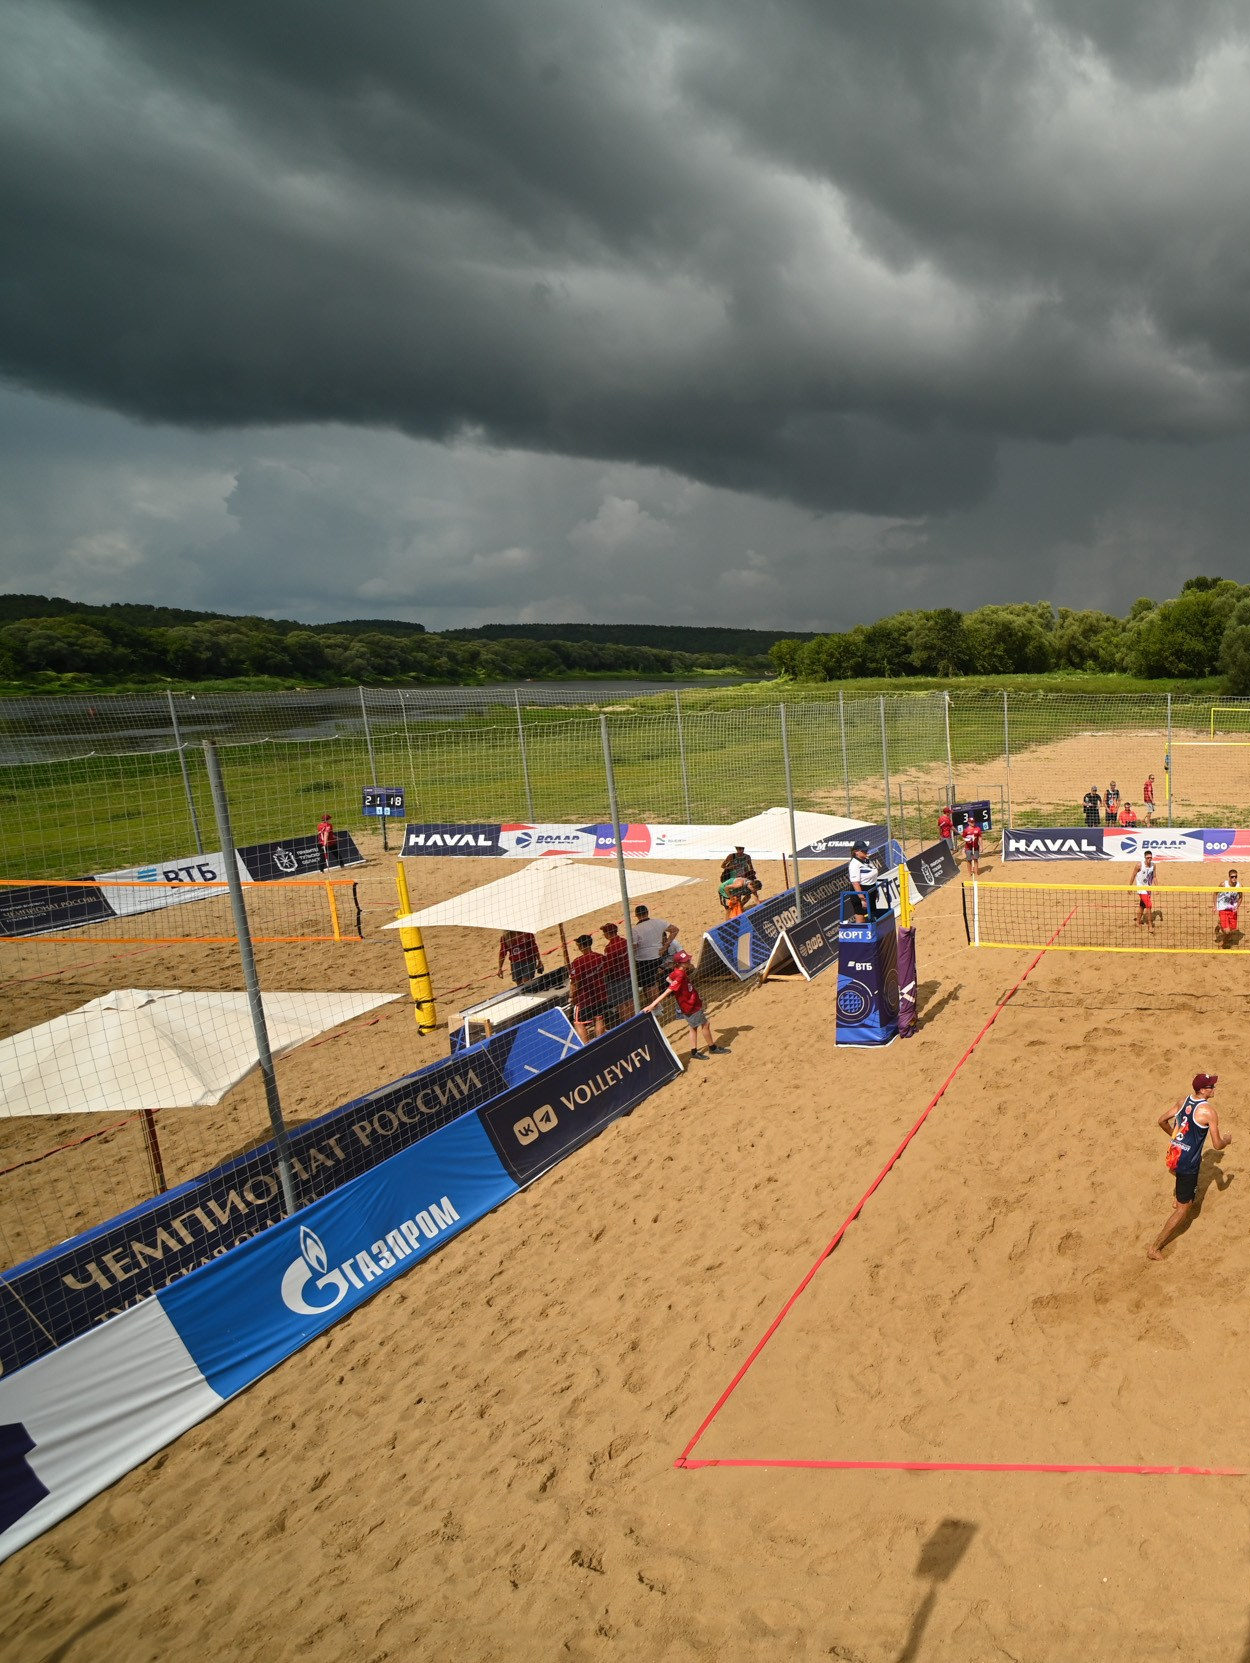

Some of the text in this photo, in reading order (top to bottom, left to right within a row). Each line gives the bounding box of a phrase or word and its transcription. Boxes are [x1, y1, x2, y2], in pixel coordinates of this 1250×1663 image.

[365, 795, 402, 806] 21 18
[963, 809, 989, 823] 3 5
[408, 833, 493, 846] HAVAL
[1009, 839, 1097, 852] HAVAL
[163, 863, 218, 889] ВТБ
[61, 896, 97, 909] РОССИИ
[838, 930, 873, 940] КОРТ 3
[805, 933, 824, 955] ВФВ
[855, 962, 873, 971] ВТБ
[559, 1044, 652, 1111] VOLLEYVFV
[1181, 1115, 1188, 1127] 2
[61, 1068, 483, 1291] ЧЕМПИОНАТ РОССИИ
[341, 1195, 461, 1290] ГАЗПРОМ
